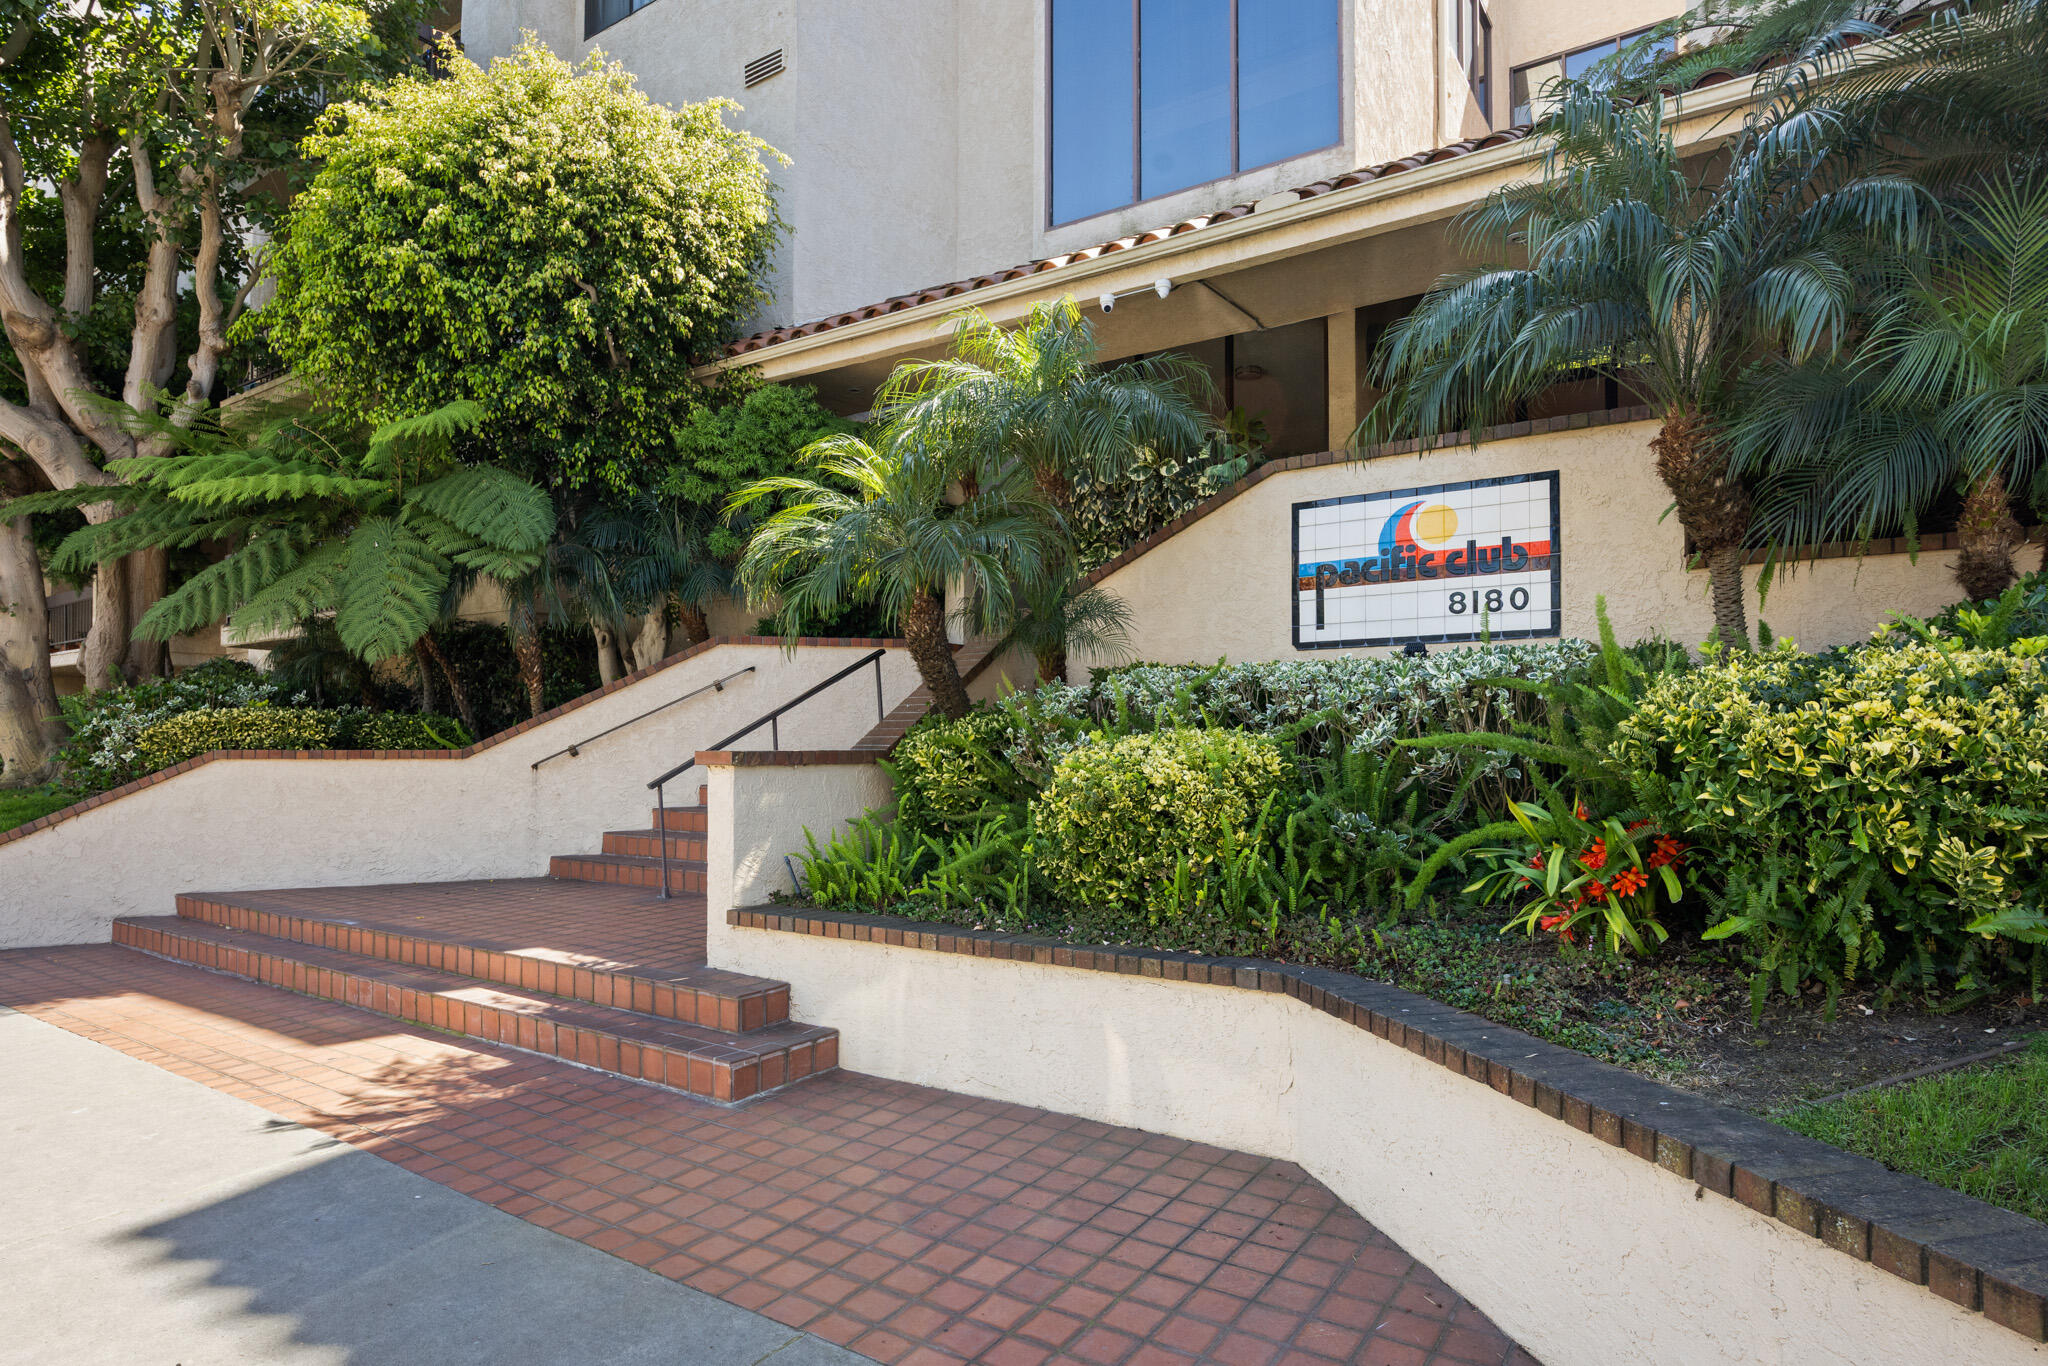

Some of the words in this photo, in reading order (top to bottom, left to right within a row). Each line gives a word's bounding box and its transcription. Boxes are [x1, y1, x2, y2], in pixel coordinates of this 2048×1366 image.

[1316, 544, 1437, 630] pacific
[1446, 536, 1529, 575] club
[1448, 587, 1530, 615] 8180
